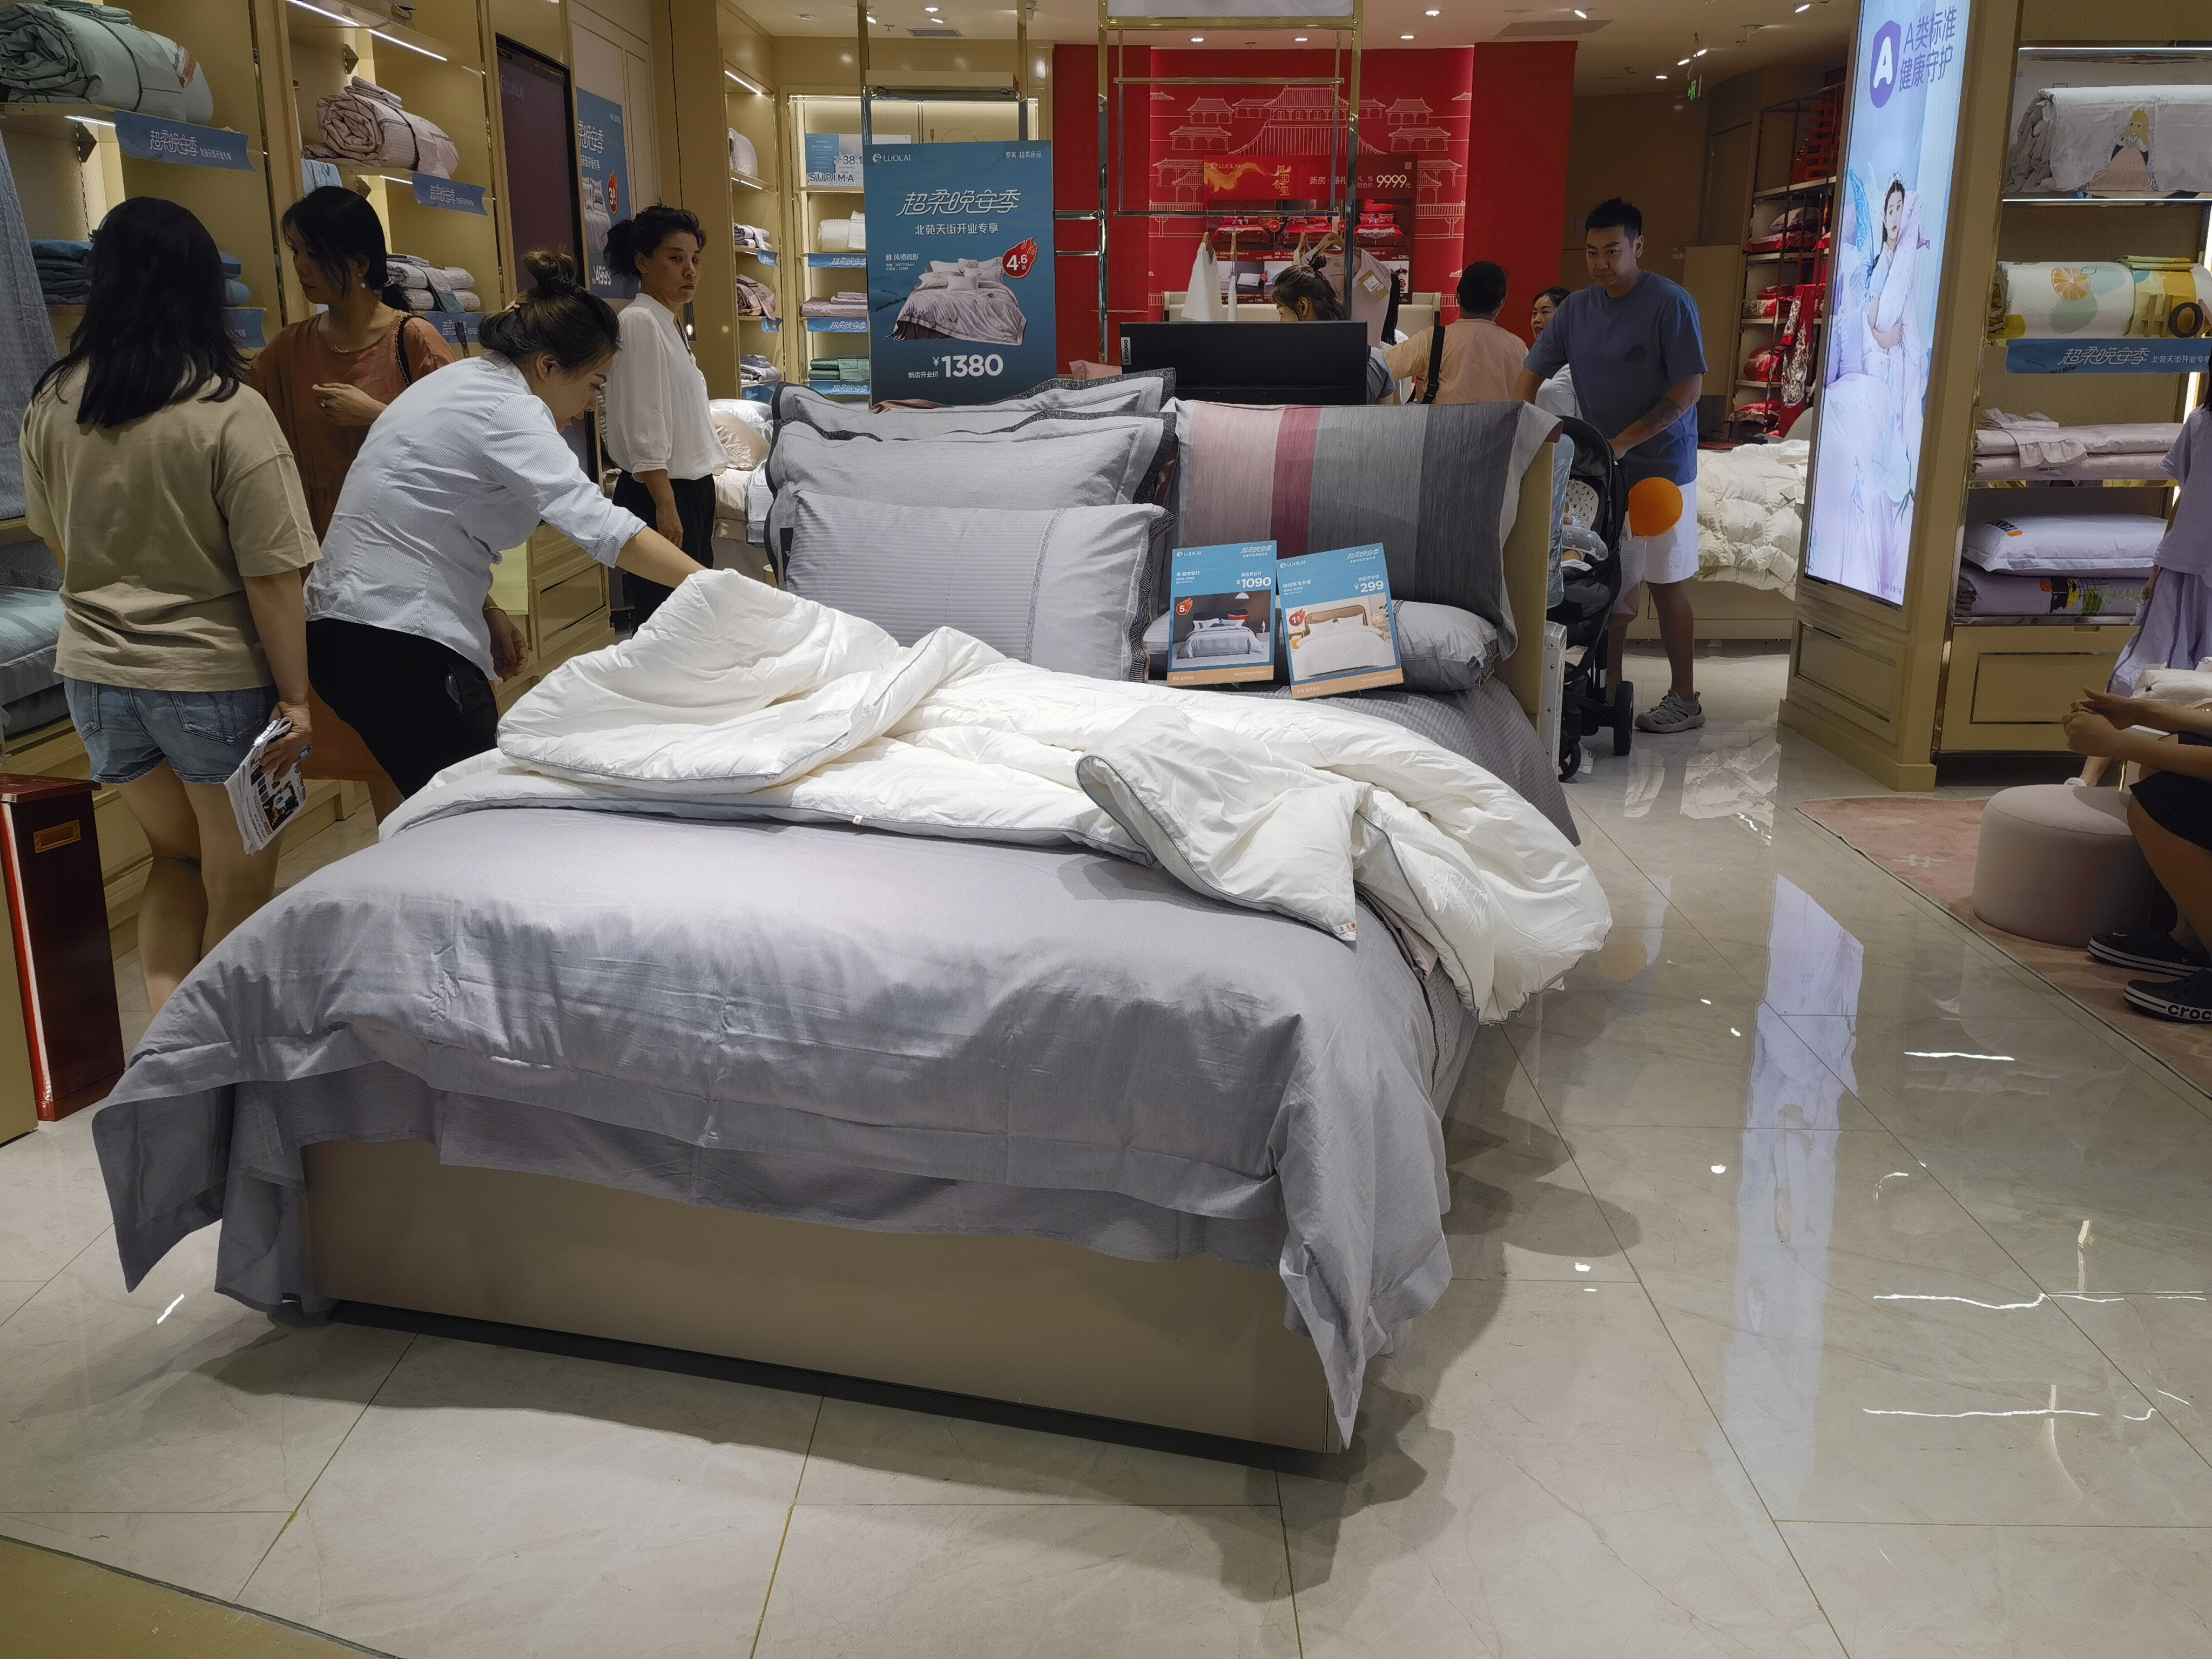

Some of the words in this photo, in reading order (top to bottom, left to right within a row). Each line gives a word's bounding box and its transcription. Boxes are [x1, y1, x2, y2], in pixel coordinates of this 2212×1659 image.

[1904, 5, 1957, 53] A类标准
[1899, 43, 1953, 92] 健康守护
[150, 129, 198, 157] 超柔晚安季
[810, 173, 854, 182] SUPIMA
[1376, 174, 1407, 188] 9999
[896, 189, 1022, 217] 超柔晚安季
[915, 223, 999, 235] 北苑天街开业专享
[1007, 254, 1028, 271] 4.6
[2058, 346, 2150, 365] 超柔晚安季
[933, 354, 1003, 377] ¥1380
[1236, 577, 1272, 589] ¥1090
[1353, 580, 1384, 593] ¥299
[2168, 1004, 2212, 1020] croc
